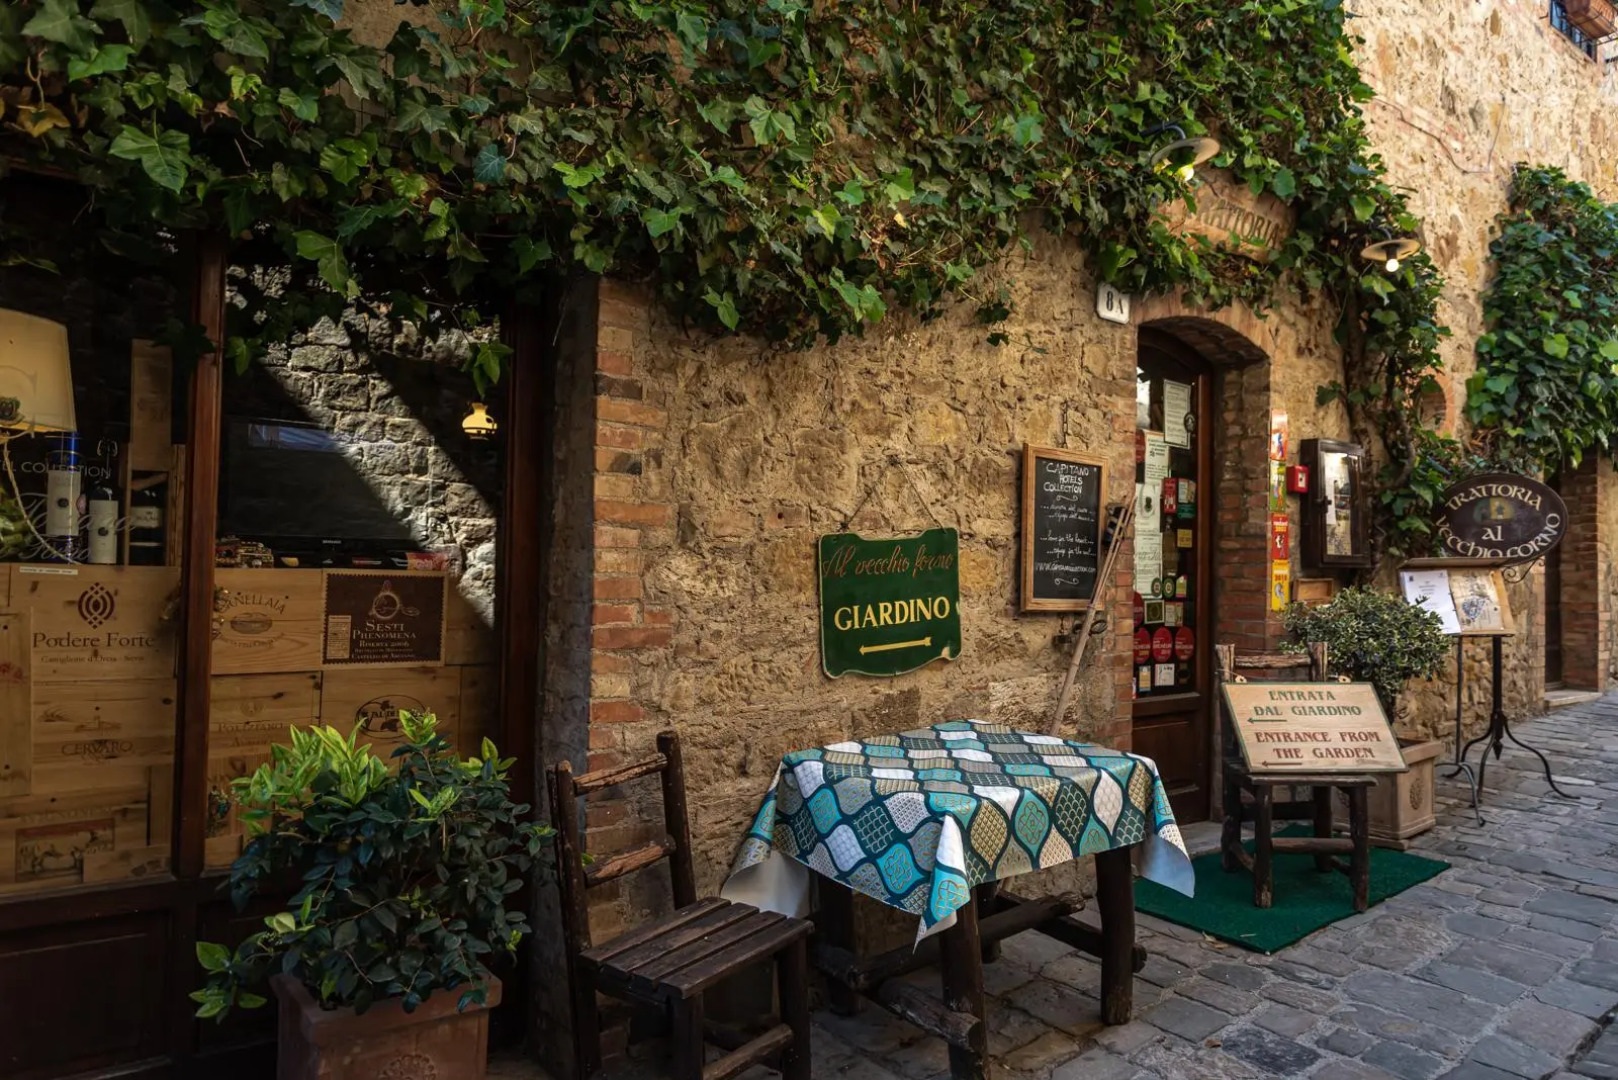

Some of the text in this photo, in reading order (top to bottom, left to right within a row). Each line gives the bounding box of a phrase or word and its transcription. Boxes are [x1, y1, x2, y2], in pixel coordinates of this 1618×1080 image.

[1045, 462, 1089, 476] CAPITANO
[1060, 474, 1083, 486] HOTELS
[1043, 482, 1083, 494] COLLECTION
[1445, 483, 1542, 511] TRATTORIA
[855, 544, 910, 575] vecchio
[912, 543, 954, 579] forno
[834, 596, 950, 631] GIARDINO
[366, 619, 405, 632] SESTI
[33, 632, 156, 648] Podere Forte
[353, 629, 416, 639] PHENOMENA
[1268, 690, 1336, 701] ENTRATA
[1254, 705, 1362, 716] DAL GIARDINO
[1255, 731, 1382, 743] ENTRANCE FROM
[1273, 747, 1376, 759] THE GARDEN
